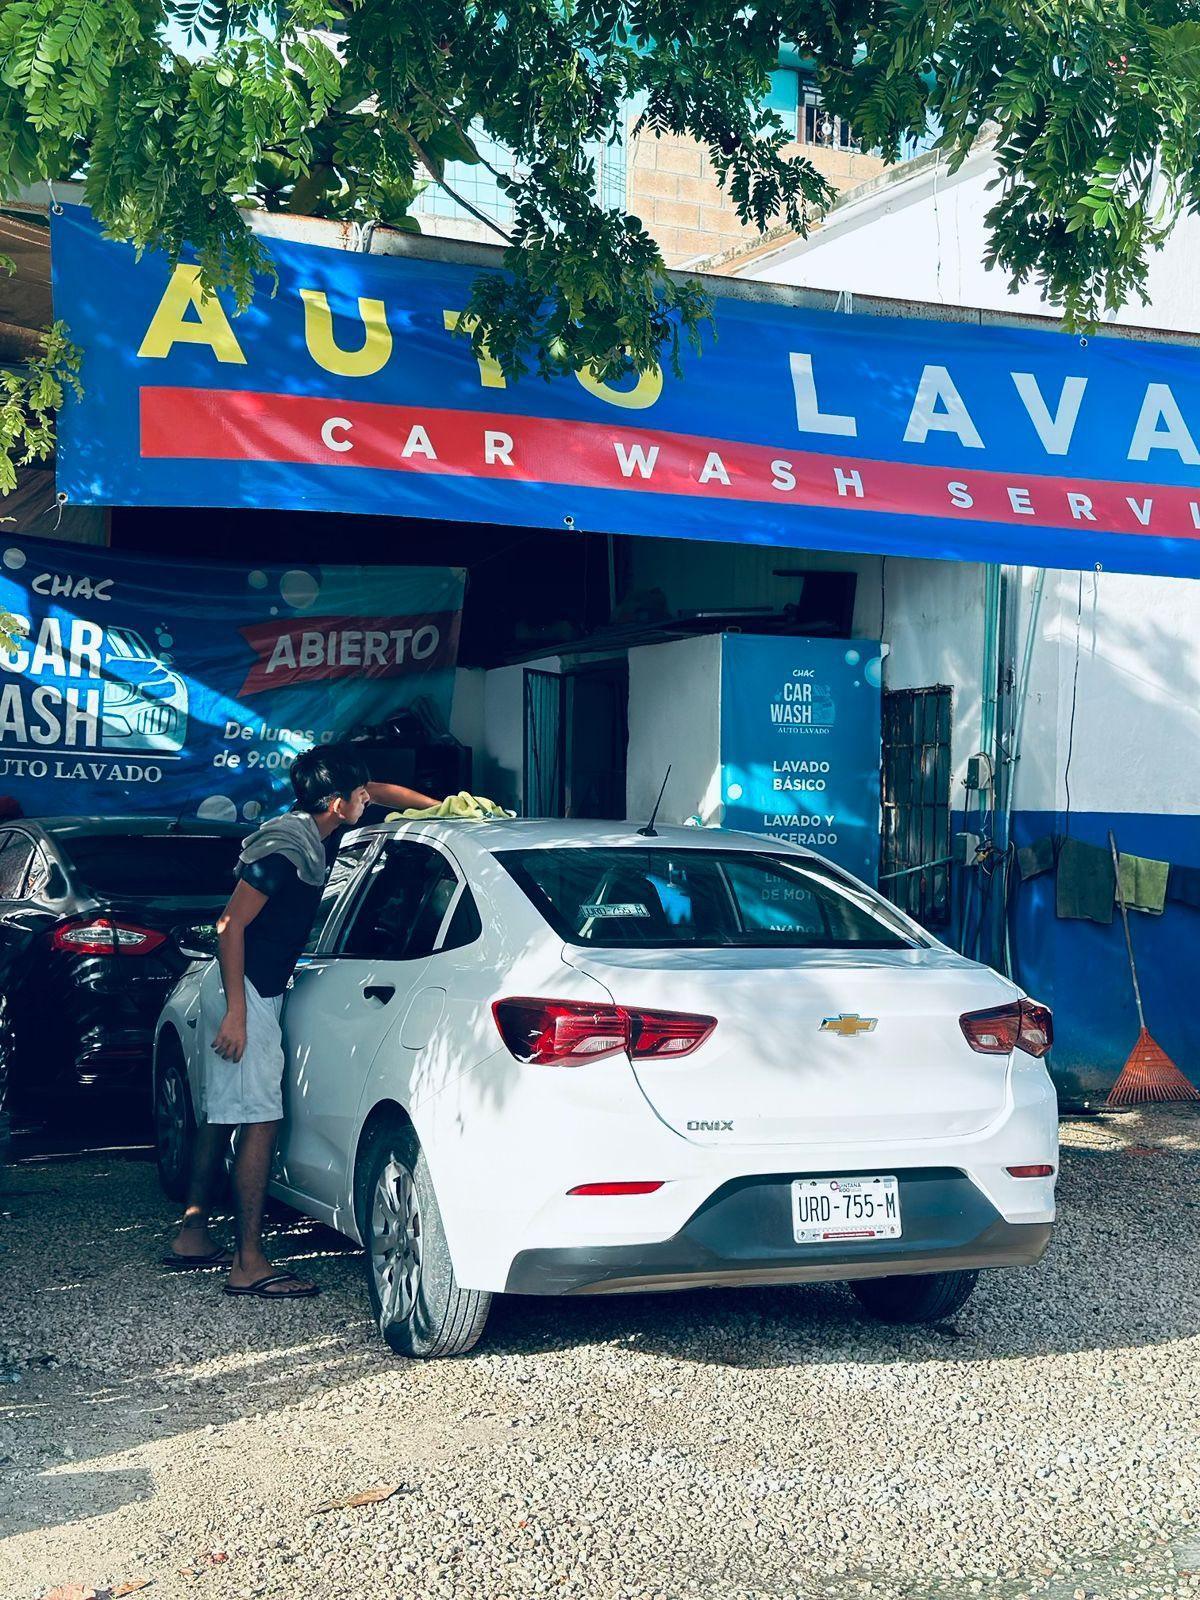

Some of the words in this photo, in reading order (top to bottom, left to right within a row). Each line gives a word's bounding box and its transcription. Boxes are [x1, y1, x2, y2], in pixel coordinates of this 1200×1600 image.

[789, 352, 1200, 466] LAVA
[320, 417, 515, 467] CAR
[614, 442, 866, 499] WASH
[31, 573, 114, 601] CHAC
[265, 624, 440, 674] ABIERTO
[792, 669, 815, 678] CHAC
[783, 682, 812, 702] CAR
[770, 703, 812, 724] WASH
[224, 721, 254, 740] De
[259, 722, 314, 743] lunes
[777, 727, 799, 735] AUTO
[800, 728, 830, 736] LAVADO
[213, 750, 241, 768] de
[772, 760, 830, 773] LAVADO
[54, 761, 162, 783] LAVADO
[772, 775, 826, 791] BÁSICO
[763, 814, 821, 827] LAVADO
[824, 814, 835, 827] Y
[686, 1119, 734, 1132] ONIX
[798, 1192, 897, 1223] URD-755-M
